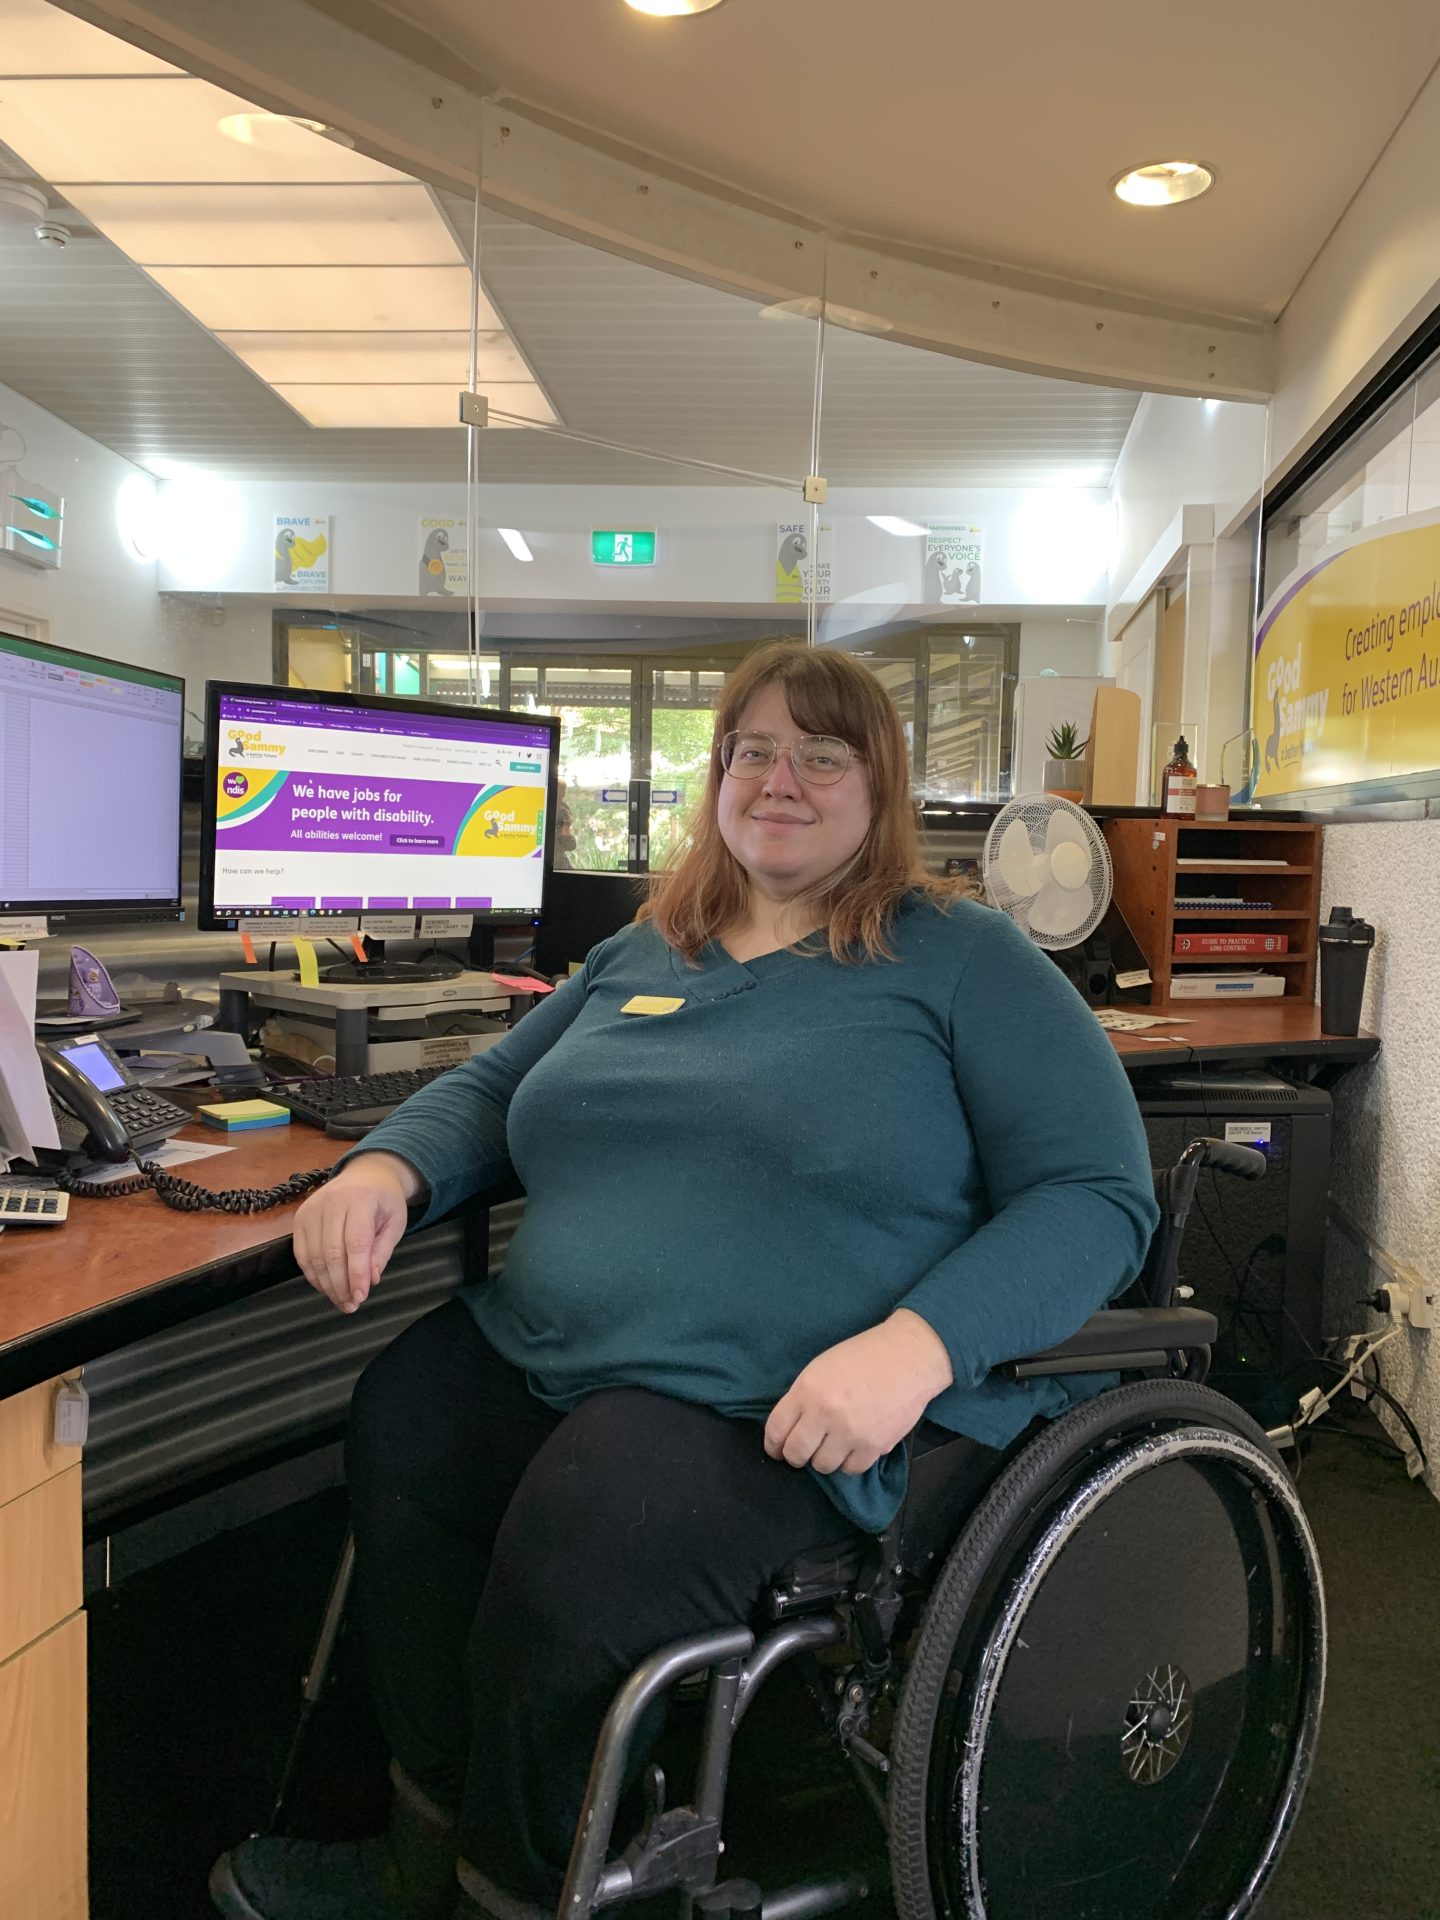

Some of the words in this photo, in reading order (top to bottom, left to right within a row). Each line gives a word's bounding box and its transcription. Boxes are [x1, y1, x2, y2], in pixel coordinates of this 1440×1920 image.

[276, 517, 310, 526] BRAVE
[422, 519, 454, 528] GOOD
[779, 524, 805, 532] SAFE
[948, 552, 980, 560] VOICE
[297, 570, 327, 578] BRAVE
[1345, 612, 1395, 662] Creating
[1266, 639, 1302, 702] Good
[1342, 683, 1358, 716] for
[1361, 666, 1413, 711] Western
[1279, 687, 1329, 738] Sammy
[227, 730, 262, 742] Good
[243, 741, 286, 755] Sammy
[227, 785, 245, 795] ndis
[292, 784, 314, 798] We
[318, 785, 350, 799] have
[352, 788, 380, 803] jobs
[383, 789, 402, 802] for
[291, 806, 338, 822] people
[341, 807, 370, 820] with
[373, 808, 434, 827] disability.
[484, 810, 515, 822] Good
[497, 822, 537, 835] Sammy
[291, 829, 302, 838] All
[305, 829, 339, 840] abilities
[342, 832, 383, 841] welcome!
[265, 867, 285, 876] help?
